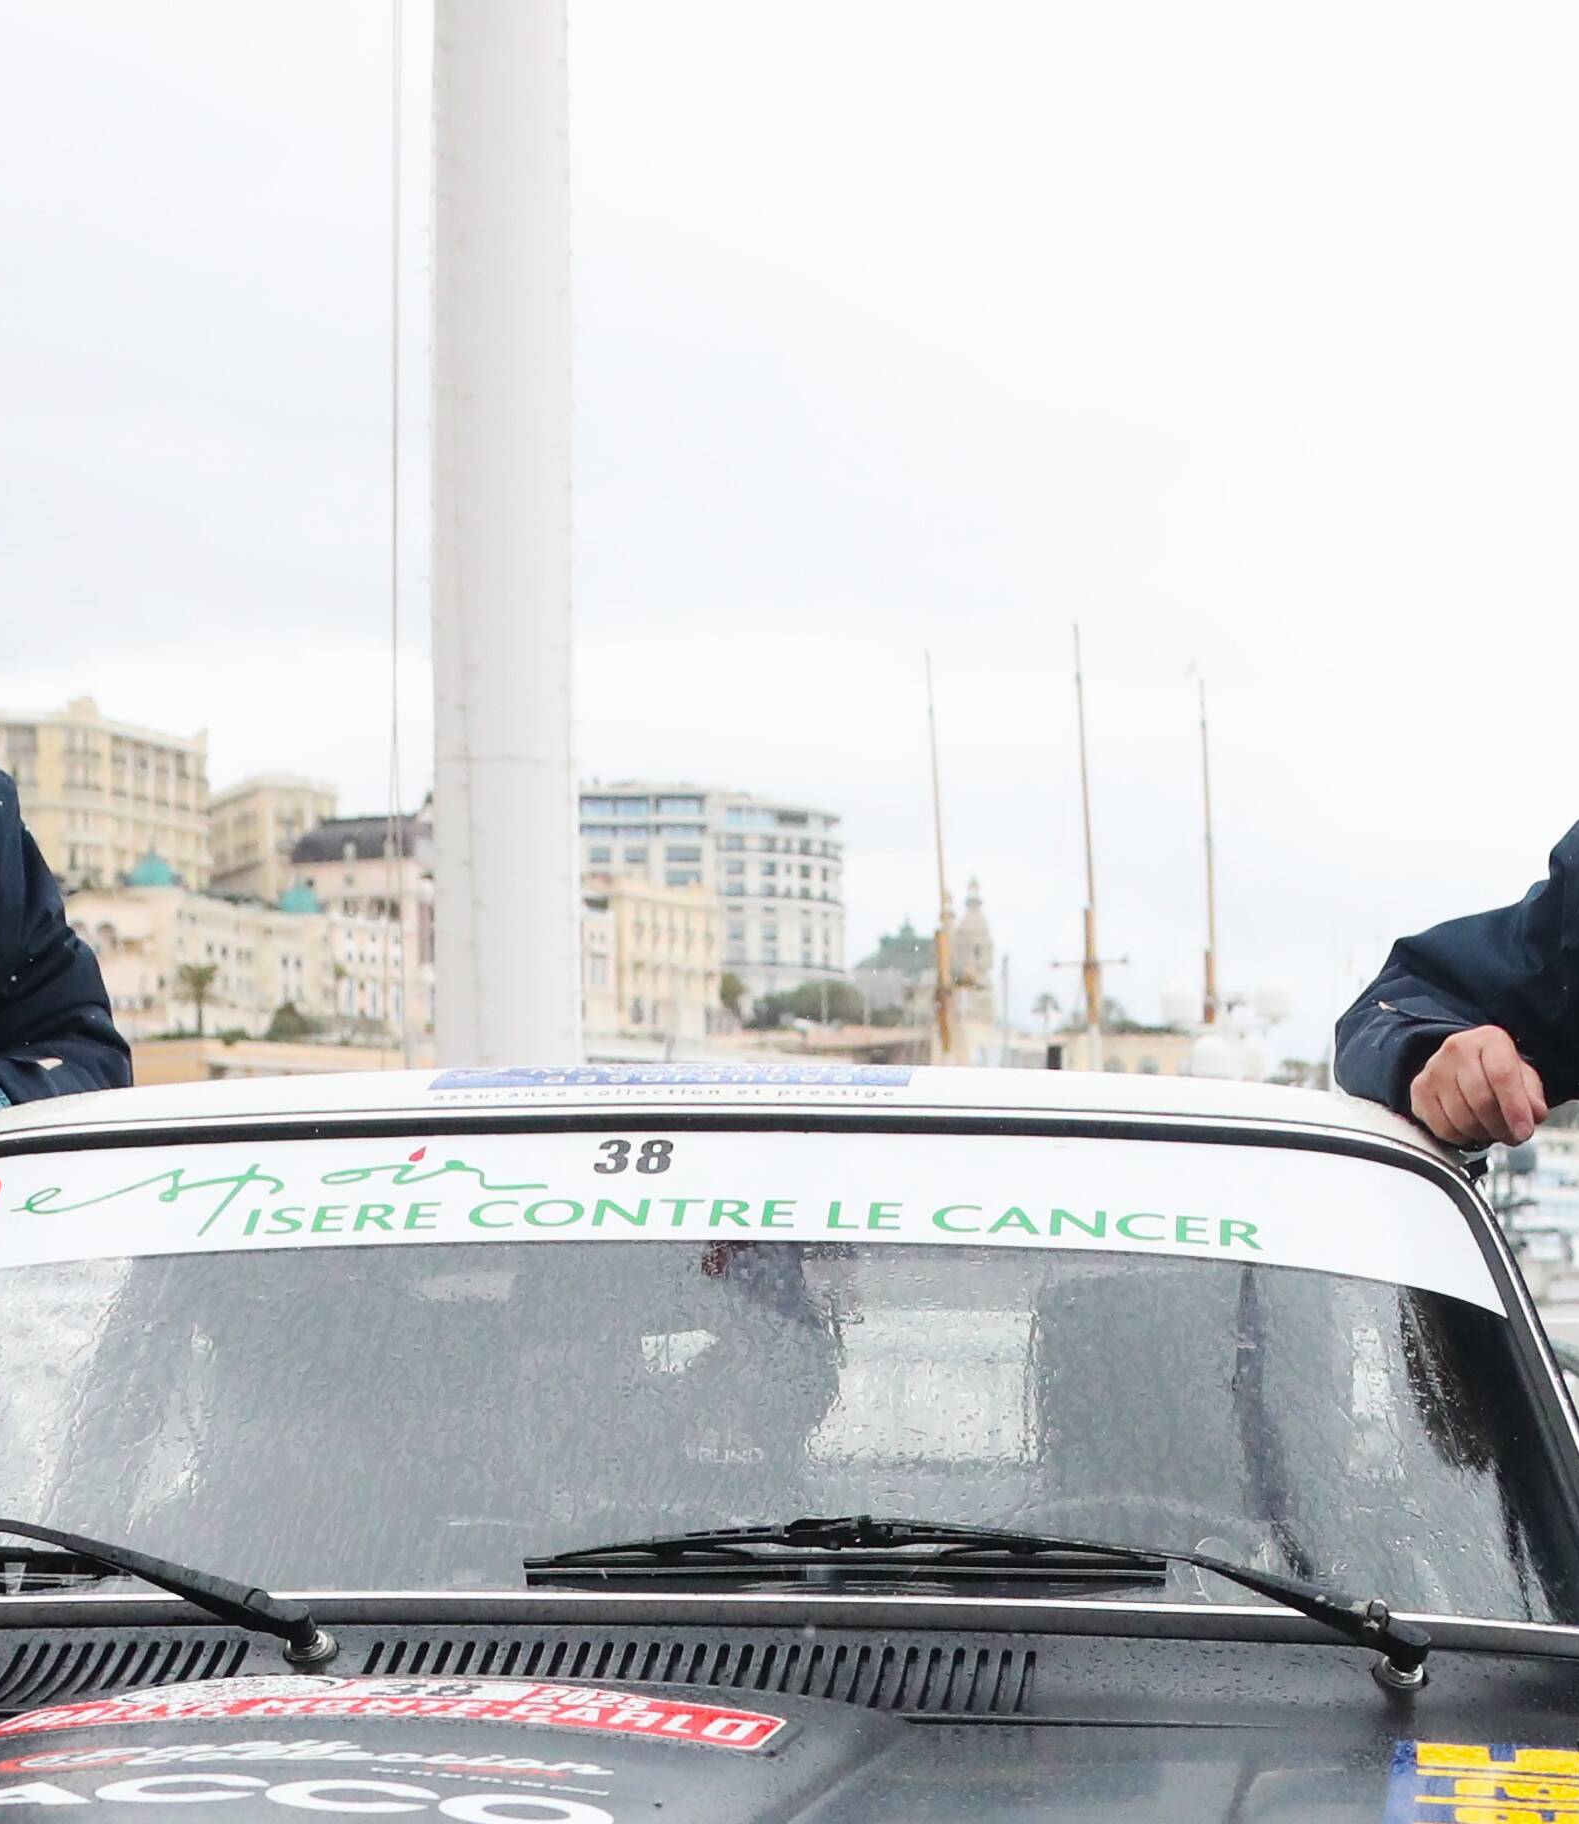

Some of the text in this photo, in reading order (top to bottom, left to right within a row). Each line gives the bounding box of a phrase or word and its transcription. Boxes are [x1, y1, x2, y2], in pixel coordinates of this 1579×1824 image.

[433, 1089, 568, 1101] assurance
[583, 1087, 721, 1097] collection
[777, 1088, 895, 1098] prestige
[593, 1139, 674, 1174] 38
[10, 1146, 548, 1237] espoir
[243, 1198, 1265, 1250] ISERE CONTRE LE CANCER
[368, 1682, 652, 1711] 38 2025
